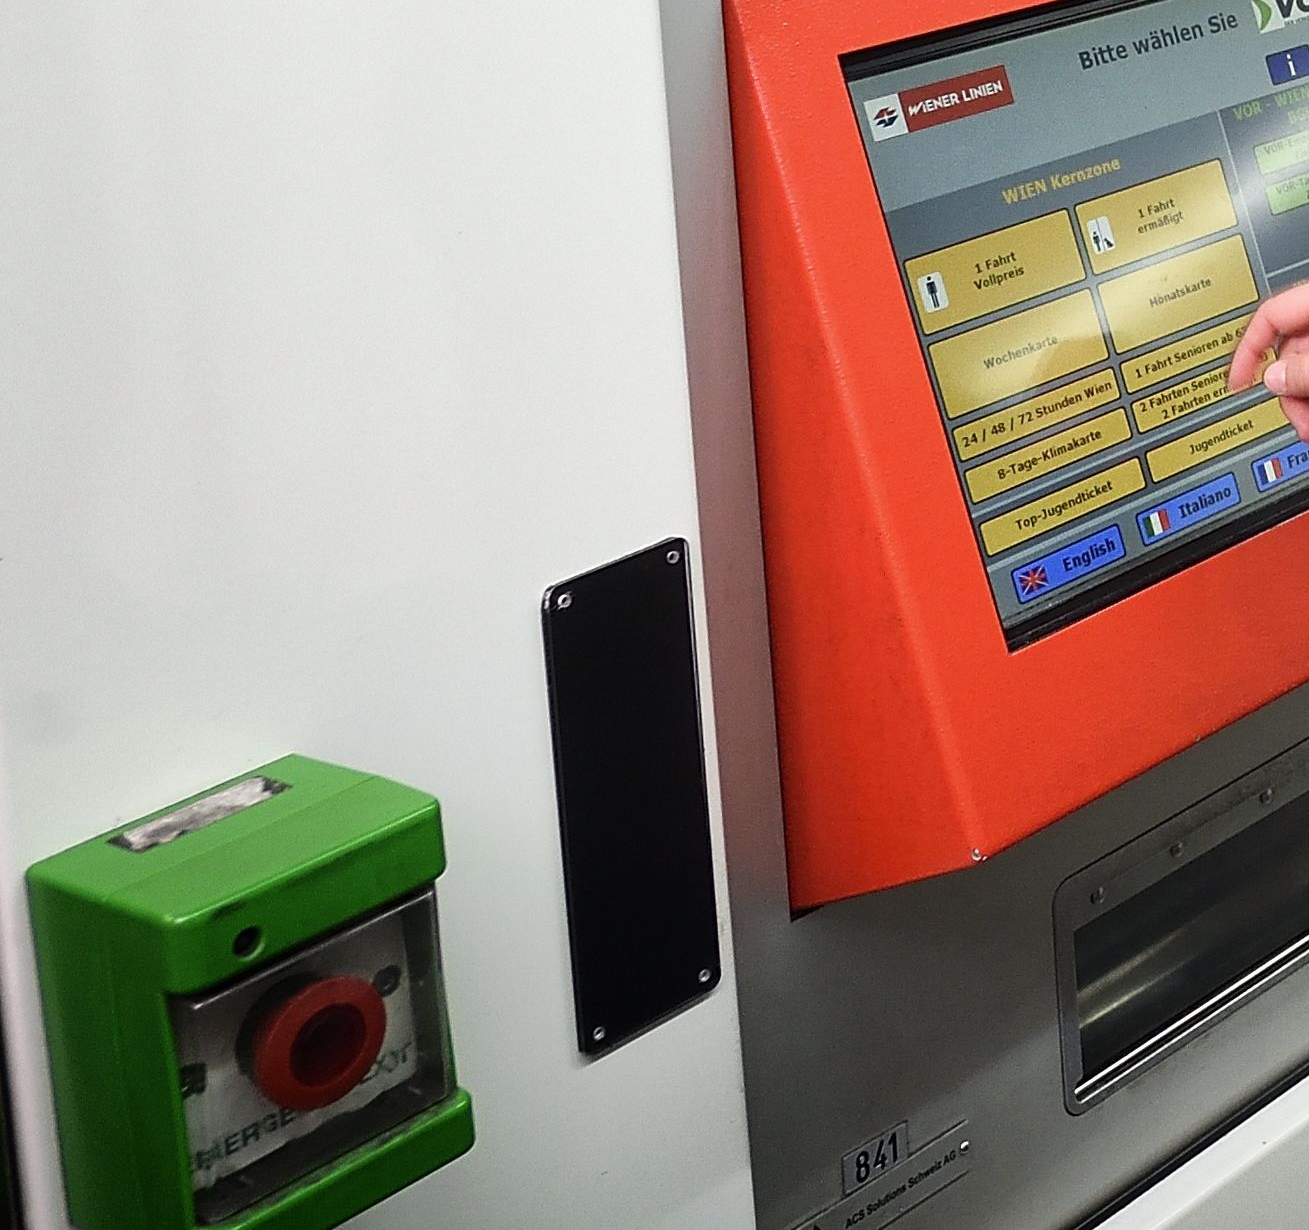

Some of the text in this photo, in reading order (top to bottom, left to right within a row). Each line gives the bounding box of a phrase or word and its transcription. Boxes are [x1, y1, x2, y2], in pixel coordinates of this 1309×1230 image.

[1078, 12, 1239, 70] Bitte wählen Sie
[908, 80, 1003, 116] WIENER LINIEN
[1232, 101, 1263, 122] VOR
[1002, 157, 1121, 205] WIEN Kernzone
[1137, 197, 1176, 219] 1 Fahrt
[1137, 210, 1184, 235] ermäßigt
[973, 265, 1025, 290] Vollpreis
[974, 251, 1017, 274] 1 Fahrt
[983, 335, 1058, 370] Wochenkarte
[1135, 367, 1143, 379] 1
[1144, 355, 1174, 376] Fahrt
[1174, 338, 1220, 363] Senioren
[1221, 331, 1234, 345] ab
[1139, 401, 1148, 413] 2
[1149, 384, 1190, 409] Fahrten
[1191, 370, 1229, 391] Seniore
[1161, 391, 1212, 420] 2 Fahrten
[962, 432, 979, 448] 24
[991, 422, 1006, 436] 48
[1017, 411, 1034, 426] 72
[1035, 393, 1083, 419] Stunden
[1083, 380, 1113, 400] Wien
[997, 428, 1102, 480] 8-Tage-Klimakarte
[1188, 419, 1254, 456] Jugendticket
[1015, 480, 1113, 531] Top-Jugendticket
[1177, 485, 1232, 520] Italiano
[1062, 537, 1116, 573] English
[855, 1131, 899, 1183] 841
[845, 1150, 956, 1229] ACS Solutions Schweiz AG
